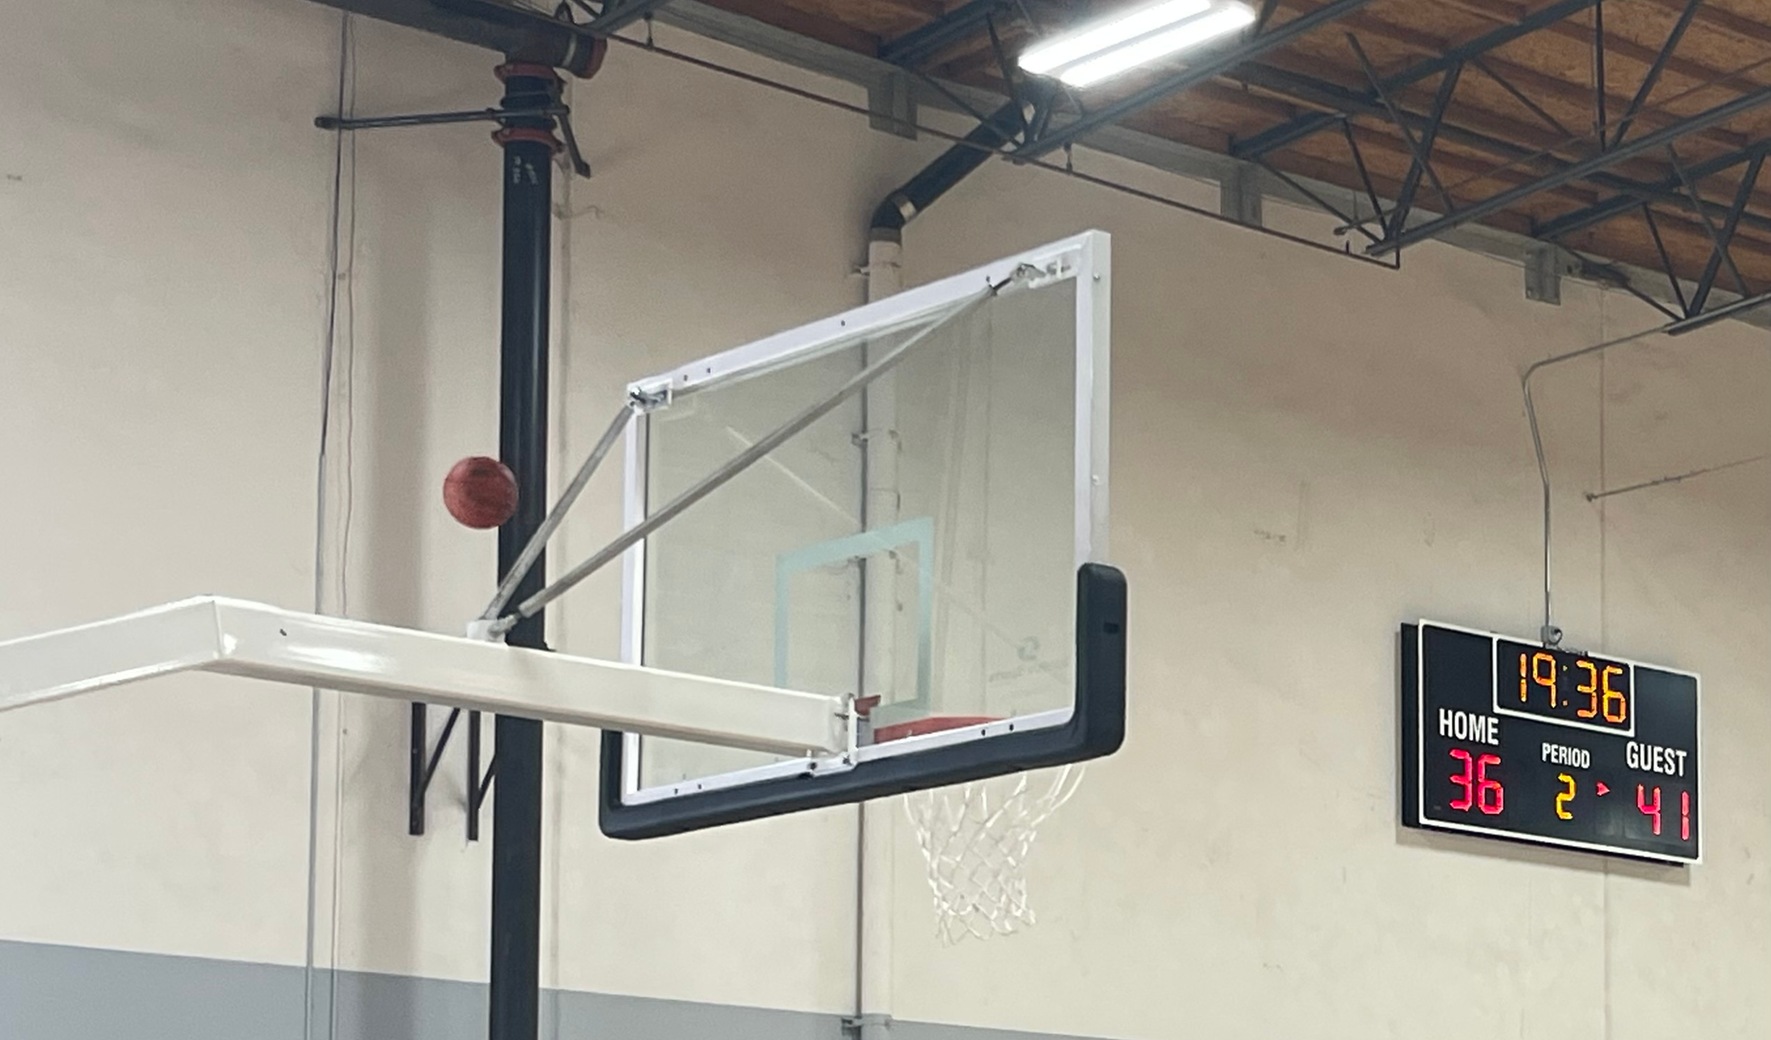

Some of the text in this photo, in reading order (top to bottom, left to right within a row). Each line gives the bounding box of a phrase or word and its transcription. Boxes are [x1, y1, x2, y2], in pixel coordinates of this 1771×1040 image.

[1519, 652, 1627, 723] 19:36
[1438, 707, 1499, 746] HOME
[1541, 742, 1590, 769] PERIOD
[1626, 740, 1687, 777] GUEST
[1449, 748, 1504, 815] 36
[1556, 772, 1577, 820] 2
[1636, 783, 1691, 841] 41
